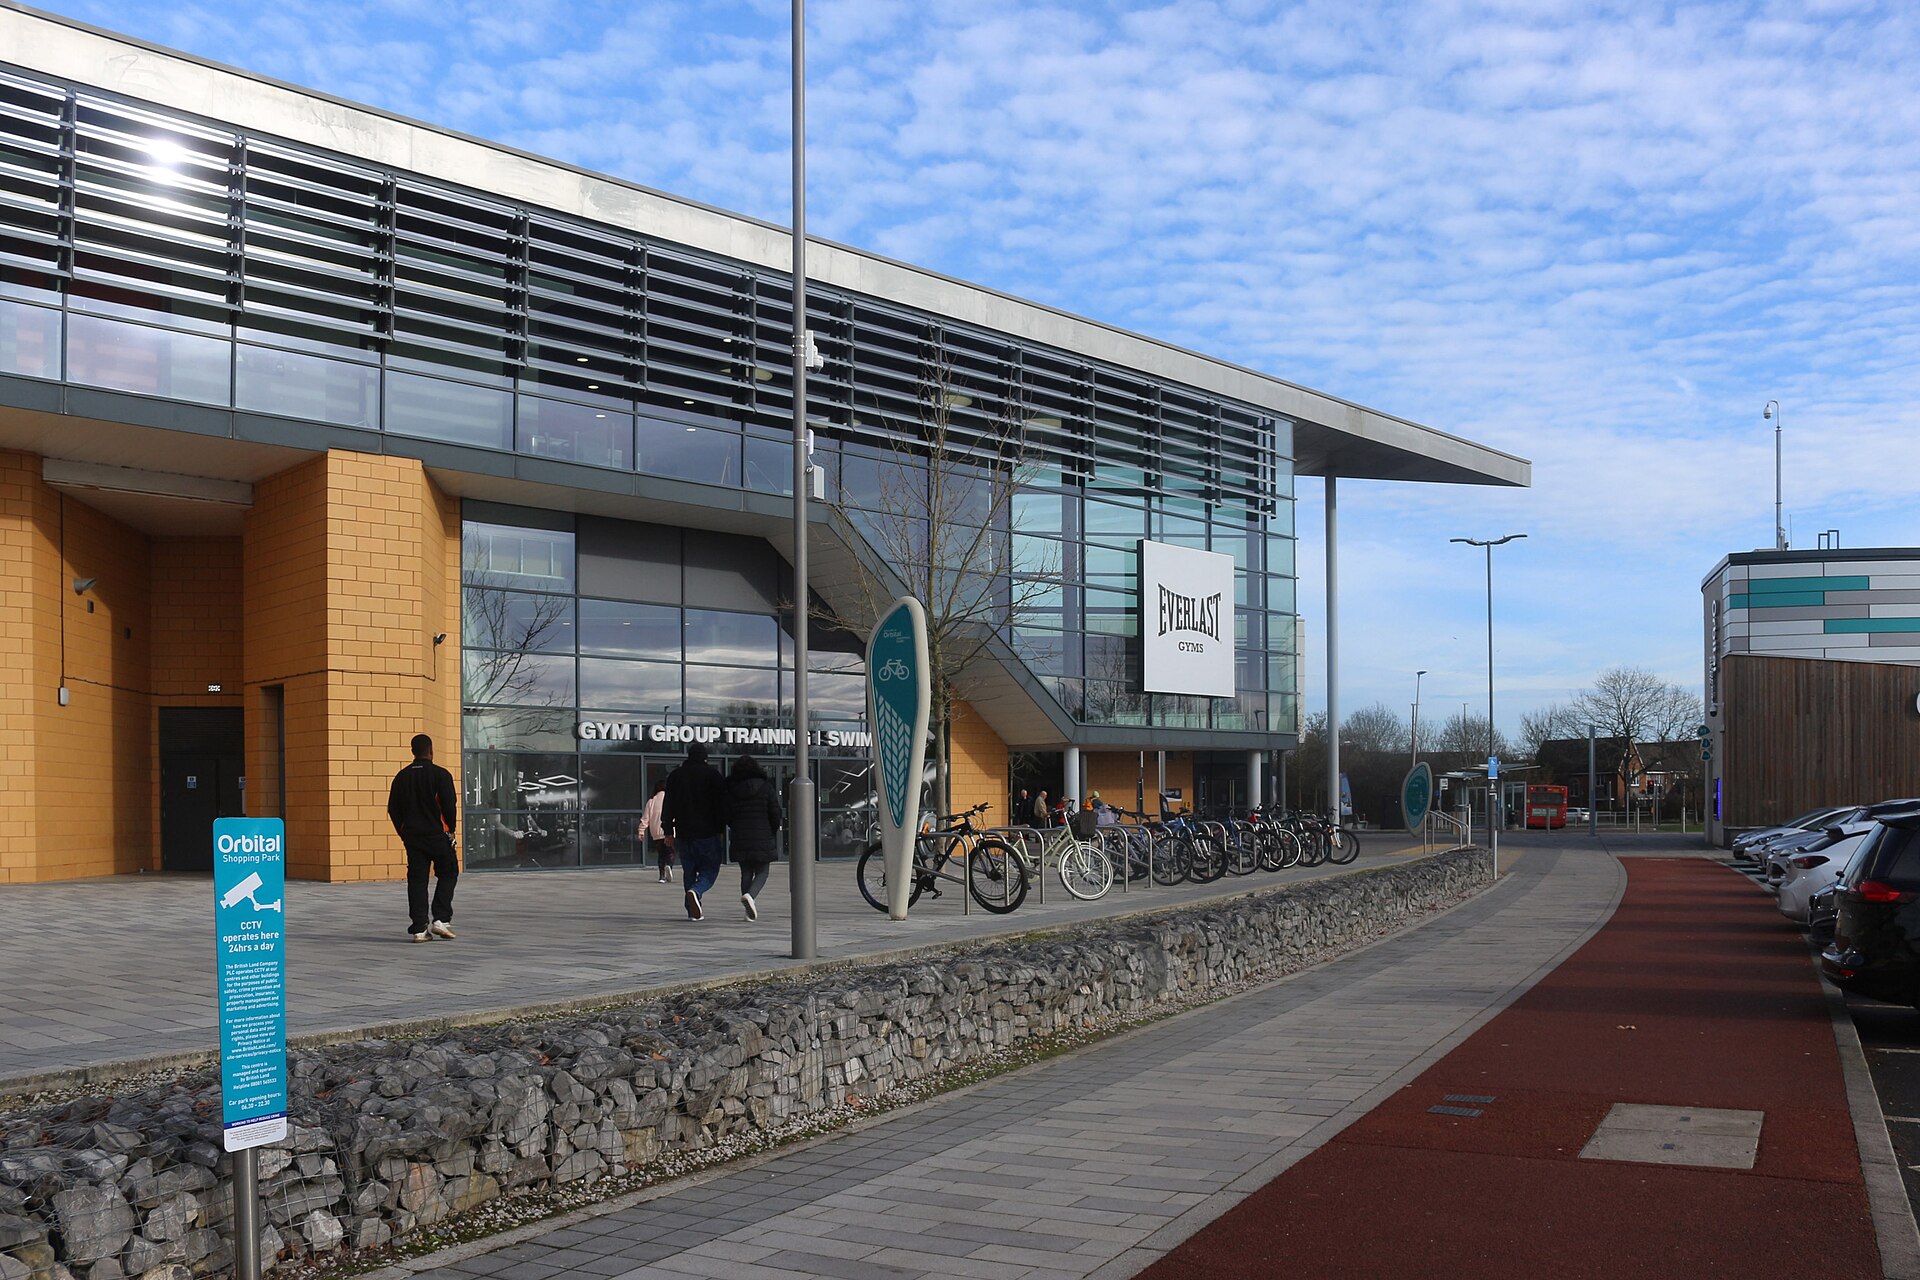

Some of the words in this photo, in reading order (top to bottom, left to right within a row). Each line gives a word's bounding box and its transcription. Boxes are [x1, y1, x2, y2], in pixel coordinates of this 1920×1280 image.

[1157, 582, 1221, 642] EVERLAST
[1178, 641, 1204, 653] GYMS
[578, 721, 630, 740] GYM
[649, 724, 721, 743] GROUP
[723, 727, 811, 745] TRAININ
[827, 730, 873, 747] SWIM
[217, 834, 280, 853] Orbital
[222, 854, 260, 864] Shopping
[262, 853, 280, 861] Park
[240, 920, 262, 930] CCTV
[223, 933, 259, 943] operates
[260, 931, 279, 939] here
[228, 944, 252, 953] 24hrs
[260, 942, 275, 951] day
